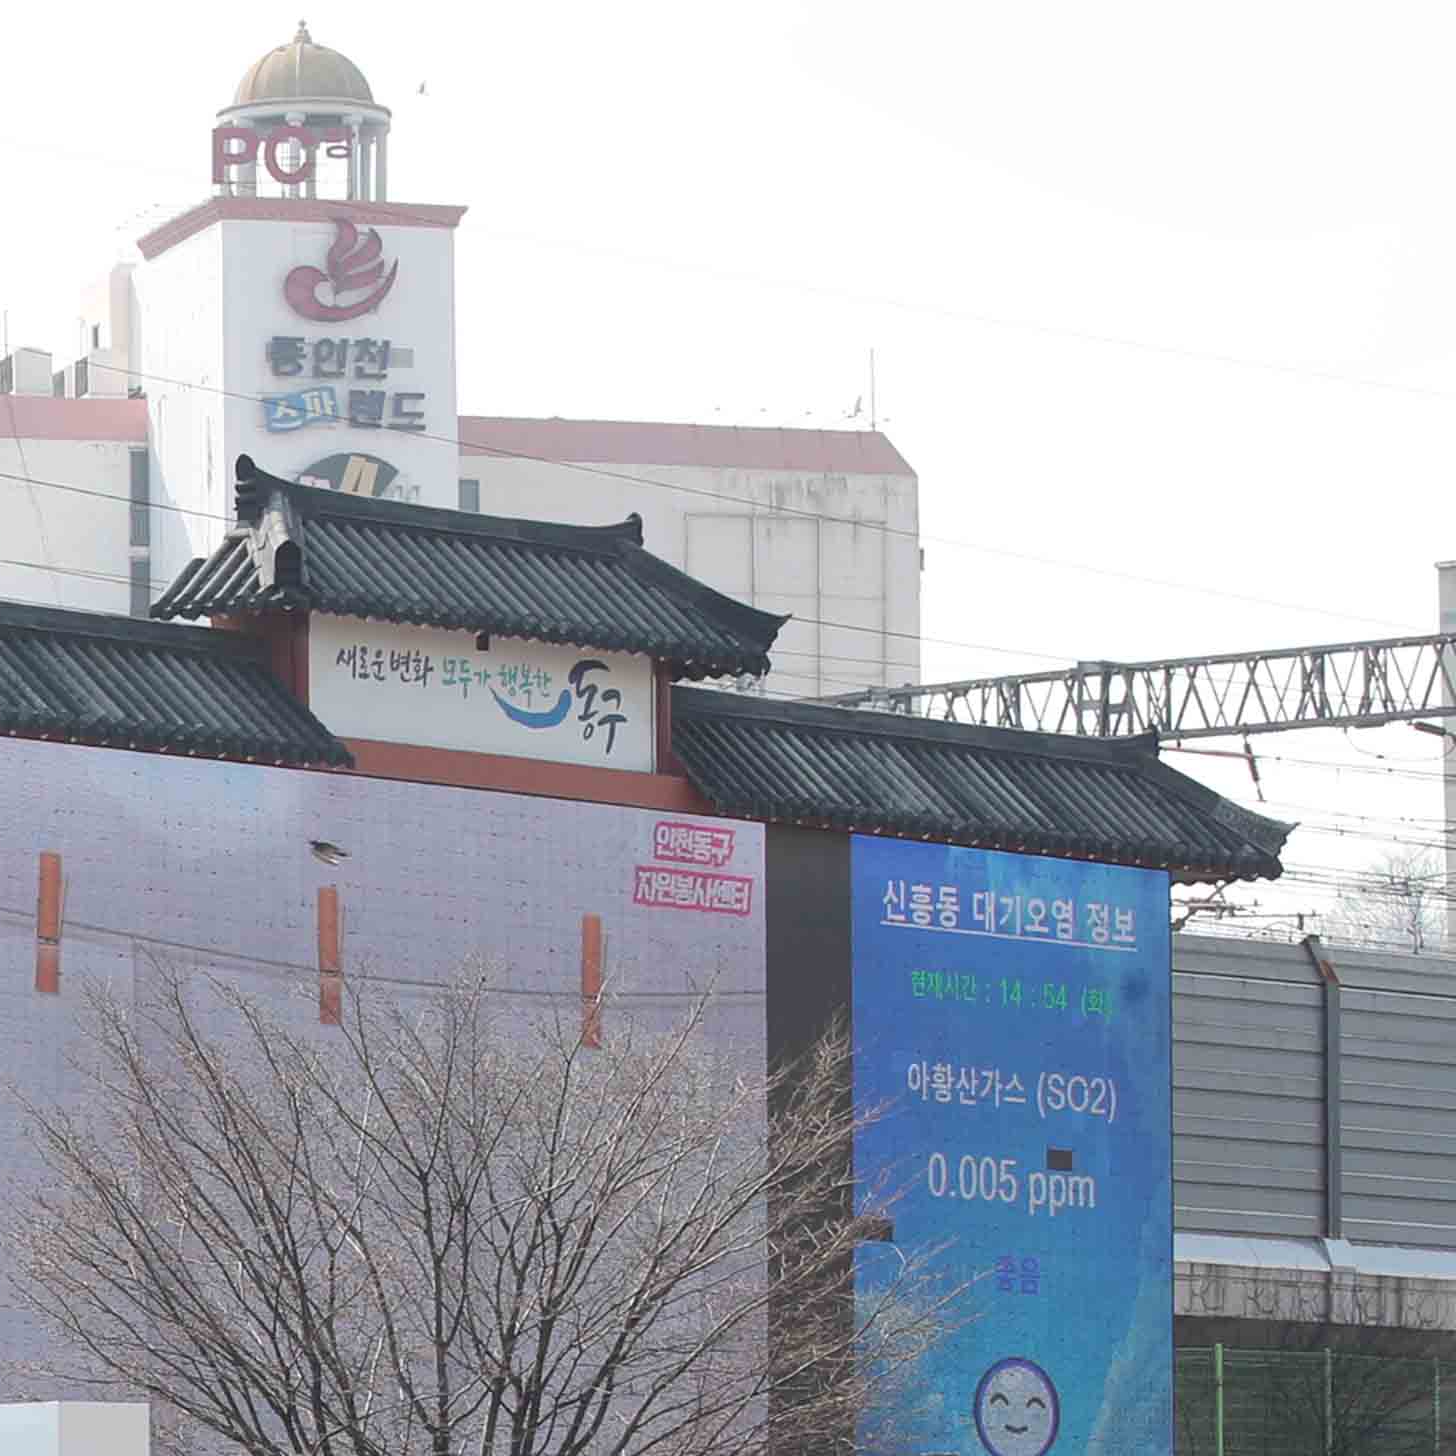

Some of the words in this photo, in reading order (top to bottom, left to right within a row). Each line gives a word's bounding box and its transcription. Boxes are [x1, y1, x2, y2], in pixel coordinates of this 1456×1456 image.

[266, 336, 391, 379] 동인천
[336, 645, 386, 681] 새로운
[390, 650, 434, 688] 변화
[442, 655, 490, 699] 모두가
[497, 663, 552, 708] 행복한
[568, 659, 628, 755] 동구
[883, 880, 960, 927] 신흥동
[973, 891, 1073, 940] 대기오염
[1087, 902, 1136, 943] 정보
[912, 970, 977, 1001] 현재시간
[1000, 978, 1023, 1009] 14
[907, 1062, 1026, 1108] 아황산가스
[1038, 1072, 1116, 1124] (SO2)
[928, 1152, 1018, 1202] 0.005
[1028, 1171, 1096, 1216] ppm
